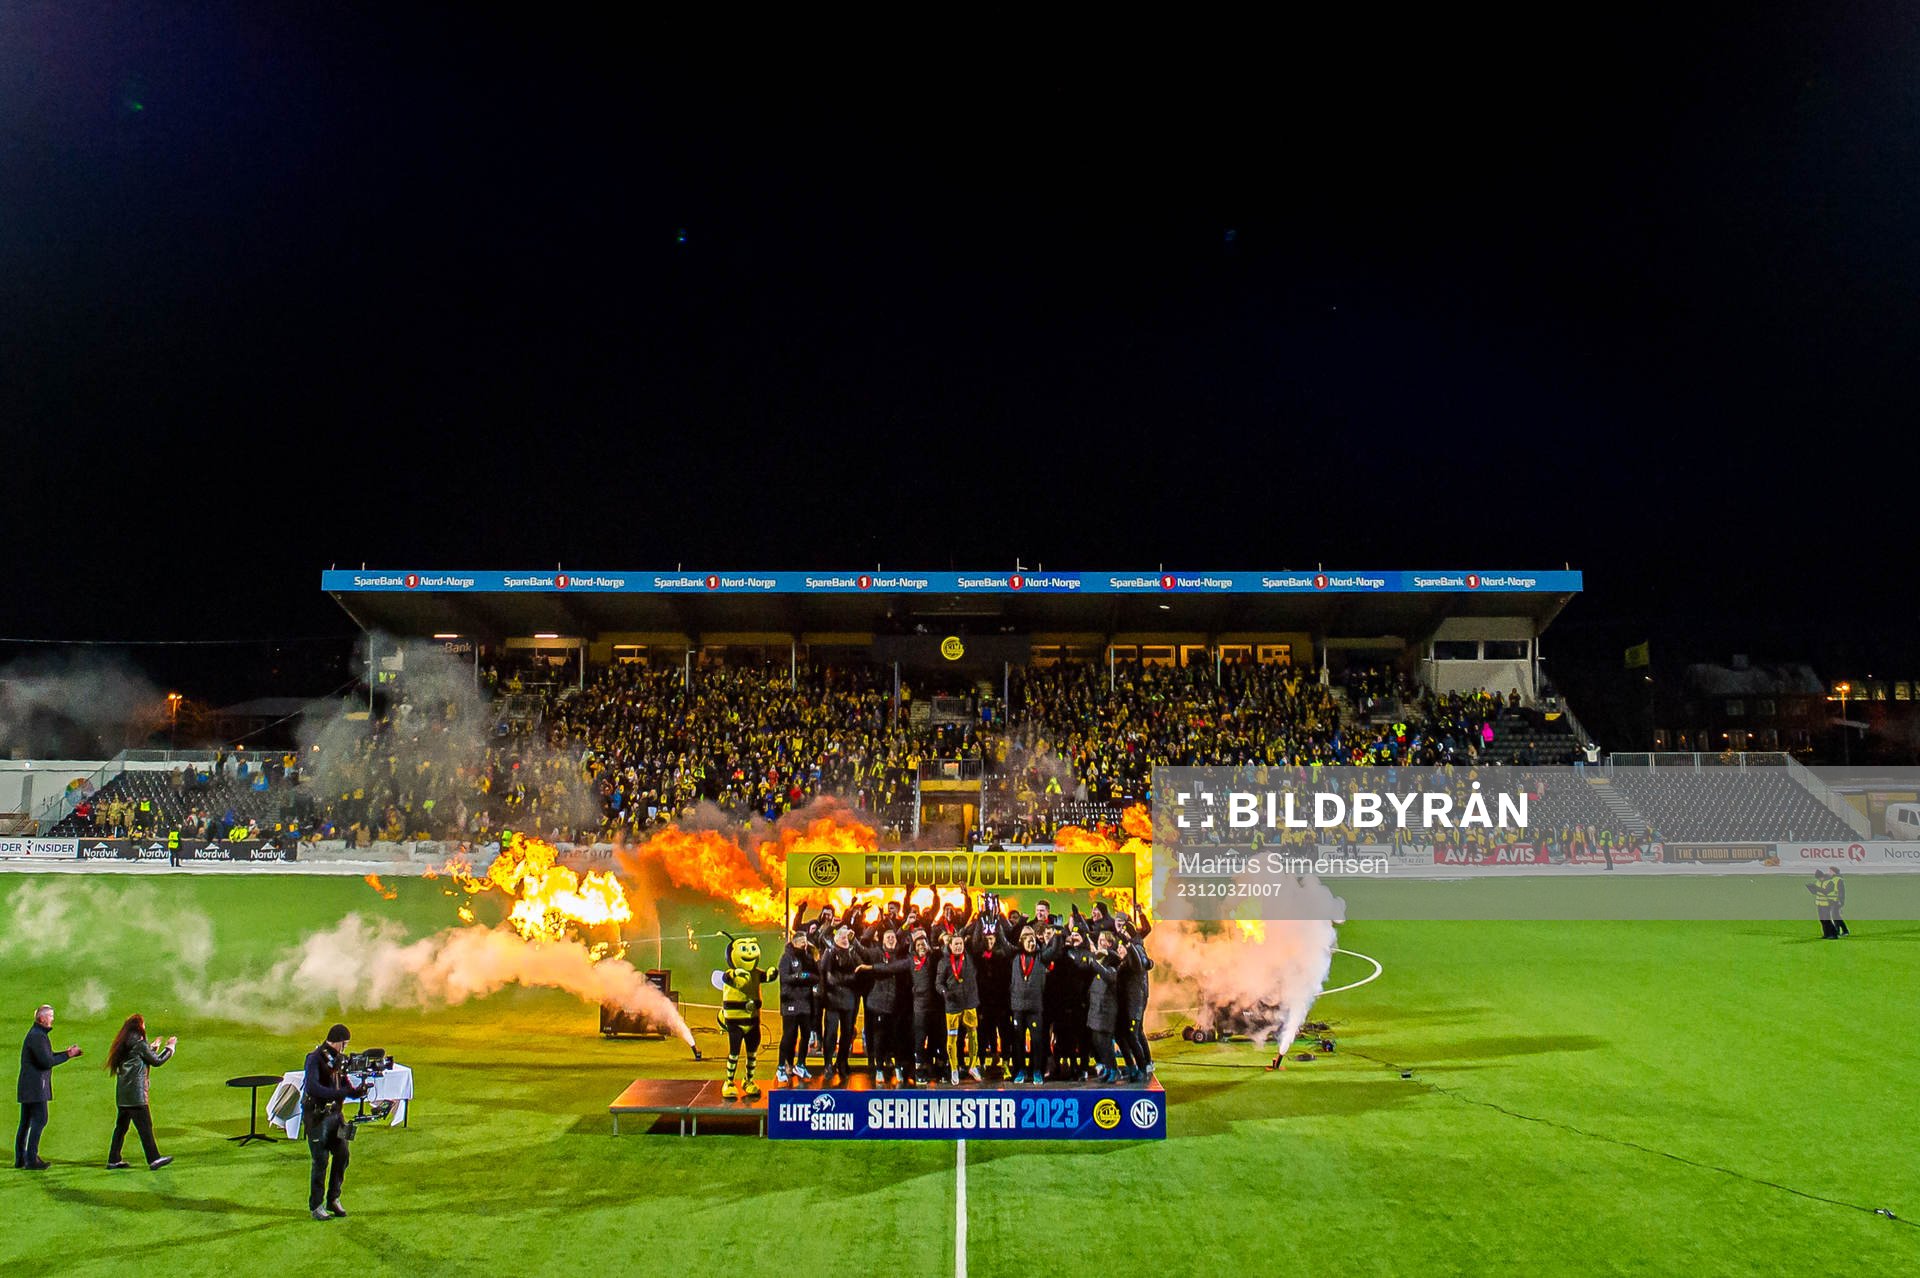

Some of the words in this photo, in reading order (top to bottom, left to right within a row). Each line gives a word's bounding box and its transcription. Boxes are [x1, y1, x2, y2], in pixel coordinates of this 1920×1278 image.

[354, 576, 404, 589] SpareBank
[420, 576, 475, 589] Nord-Norge
[503, 576, 554, 589] SpareBank
[570, 576, 625, 589] Nord-Norge
[654, 576, 705, 589] SpareBank
[721, 576, 776, 589] Nord-Norge
[805, 576, 856, 589] SpareBank
[872, 576, 928, 589] Nord-Norge
[957, 576, 1008, 589] SpareBank
[1025, 576, 1081, 589] Nord-Norge
[1109, 576, 1160, 589] SpareBank
[1177, 576, 1233, 589] Nord-Norge
[1262, 576, 1313, 589] SpareBank
[1330, 576, 1385, 589] Nord-Norge
[1413, 576, 1465, 589] SpareBank
[1481, 576, 1536, 589] Nord-Norge
[35, 843, 74, 853] INSIDER
[83, 848, 118, 858] Nordvik
[138, 848, 170, 858] Nordvi
[194, 849, 230, 859] Nordvik
[250, 849, 286, 860] Nordvik
[1678, 848, 1693, 859] THE
[1696, 848, 1729, 859] LONDON
[1732, 848, 1764, 859] BARBER
[1800, 848, 1844, 859] CIRCLE
[1496, 848, 1535, 863] AVIS
[865, 855, 896, 886] FK
[779, 1103, 812, 1122] ELITE
[867, 1097, 1017, 1129] SERIEMESTER
[1020, 1098, 1080, 1129] 2023
[810, 1113, 854, 1131] SERIEN
